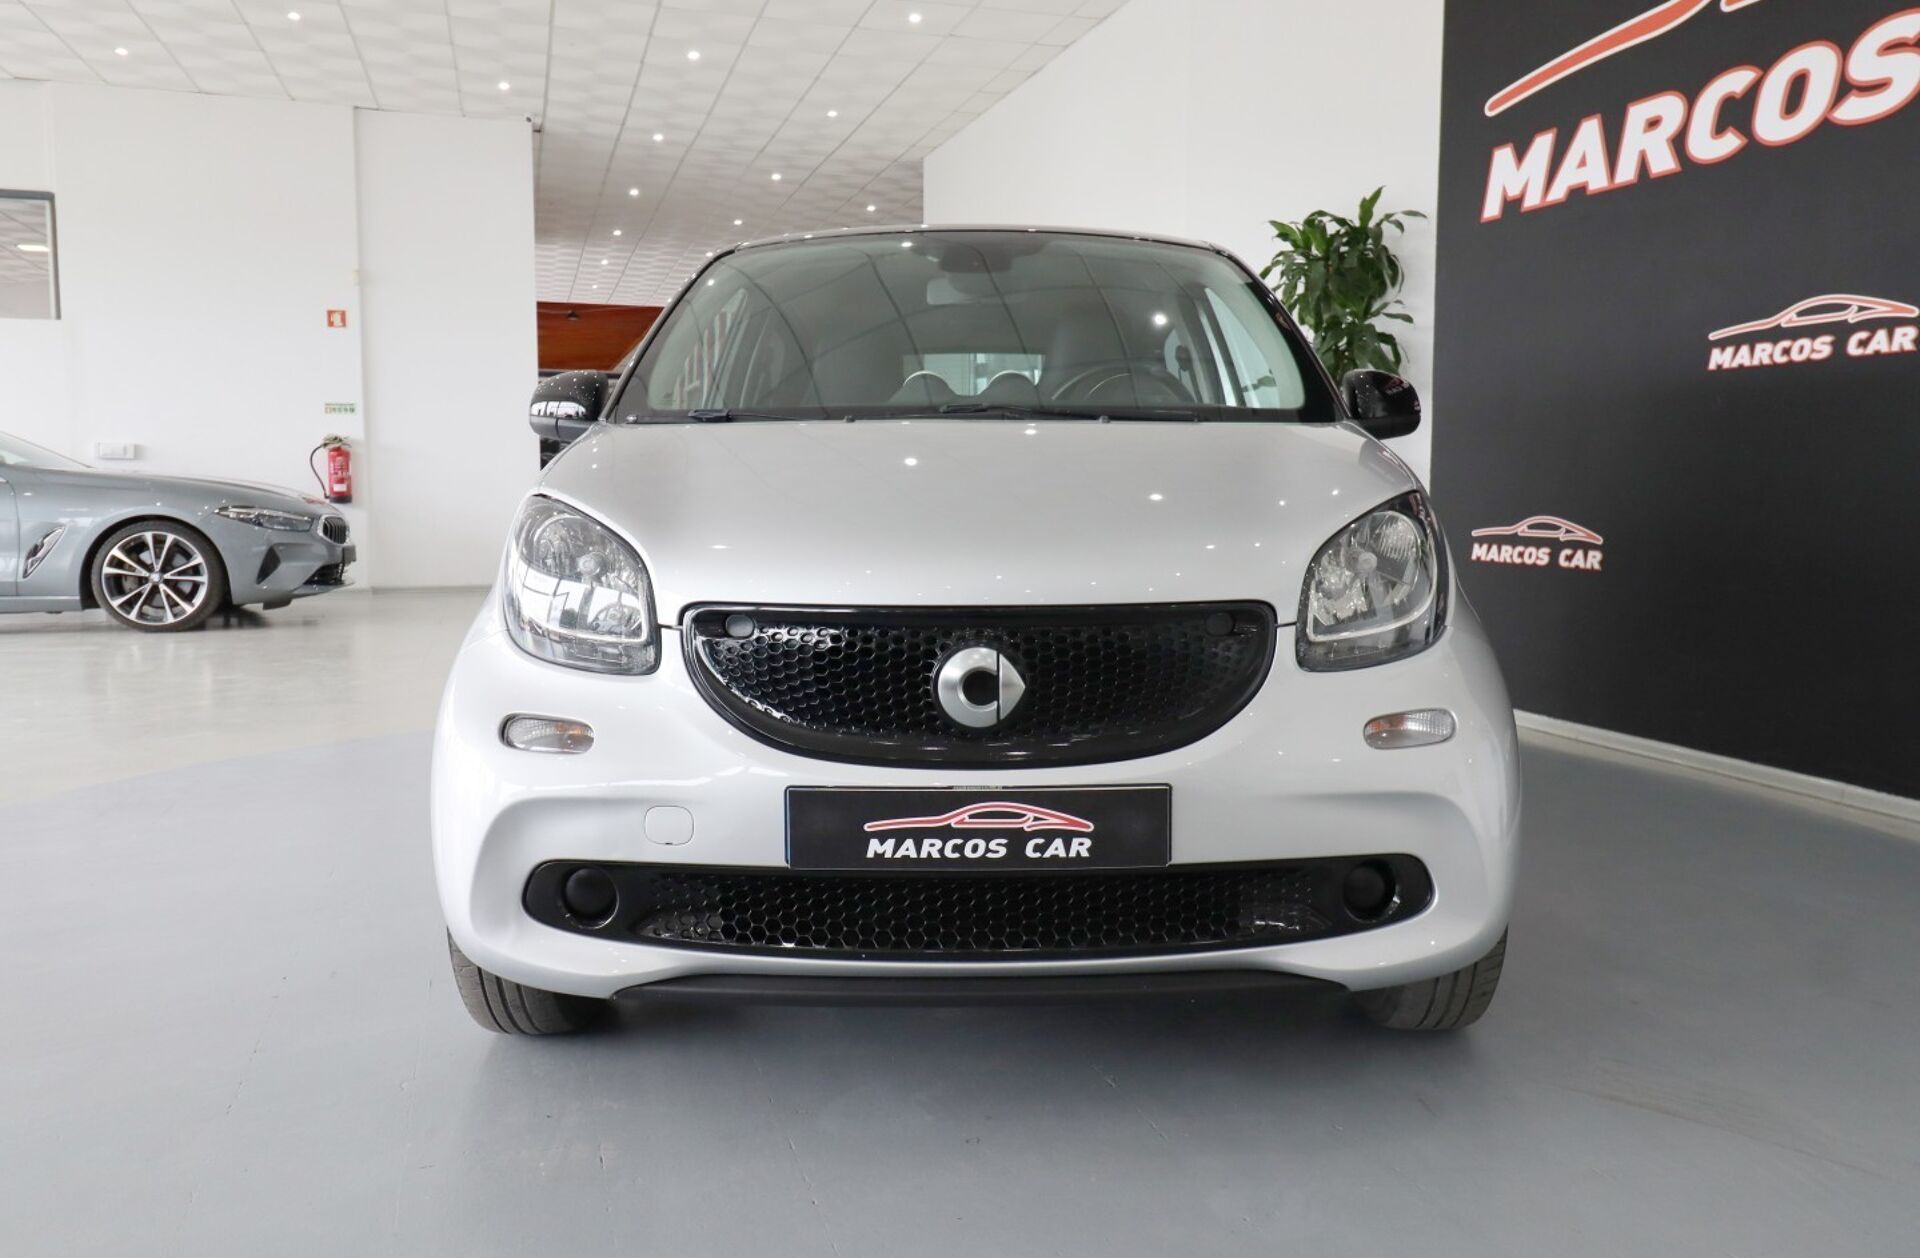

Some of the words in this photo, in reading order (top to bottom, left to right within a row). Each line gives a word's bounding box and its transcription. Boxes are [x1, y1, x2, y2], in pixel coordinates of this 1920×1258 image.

[1480, 8, 1920, 223] MARCOS
[1708, 335, 1835, 371] MARCOS
[1847, 326, 1919, 356] CAR
[1471, 543, 1551, 566] MARCOS
[1558, 548, 1603, 571] CAR
[866, 838, 1007, 859] MARCOS
[1025, 837, 1092, 858] CAR
